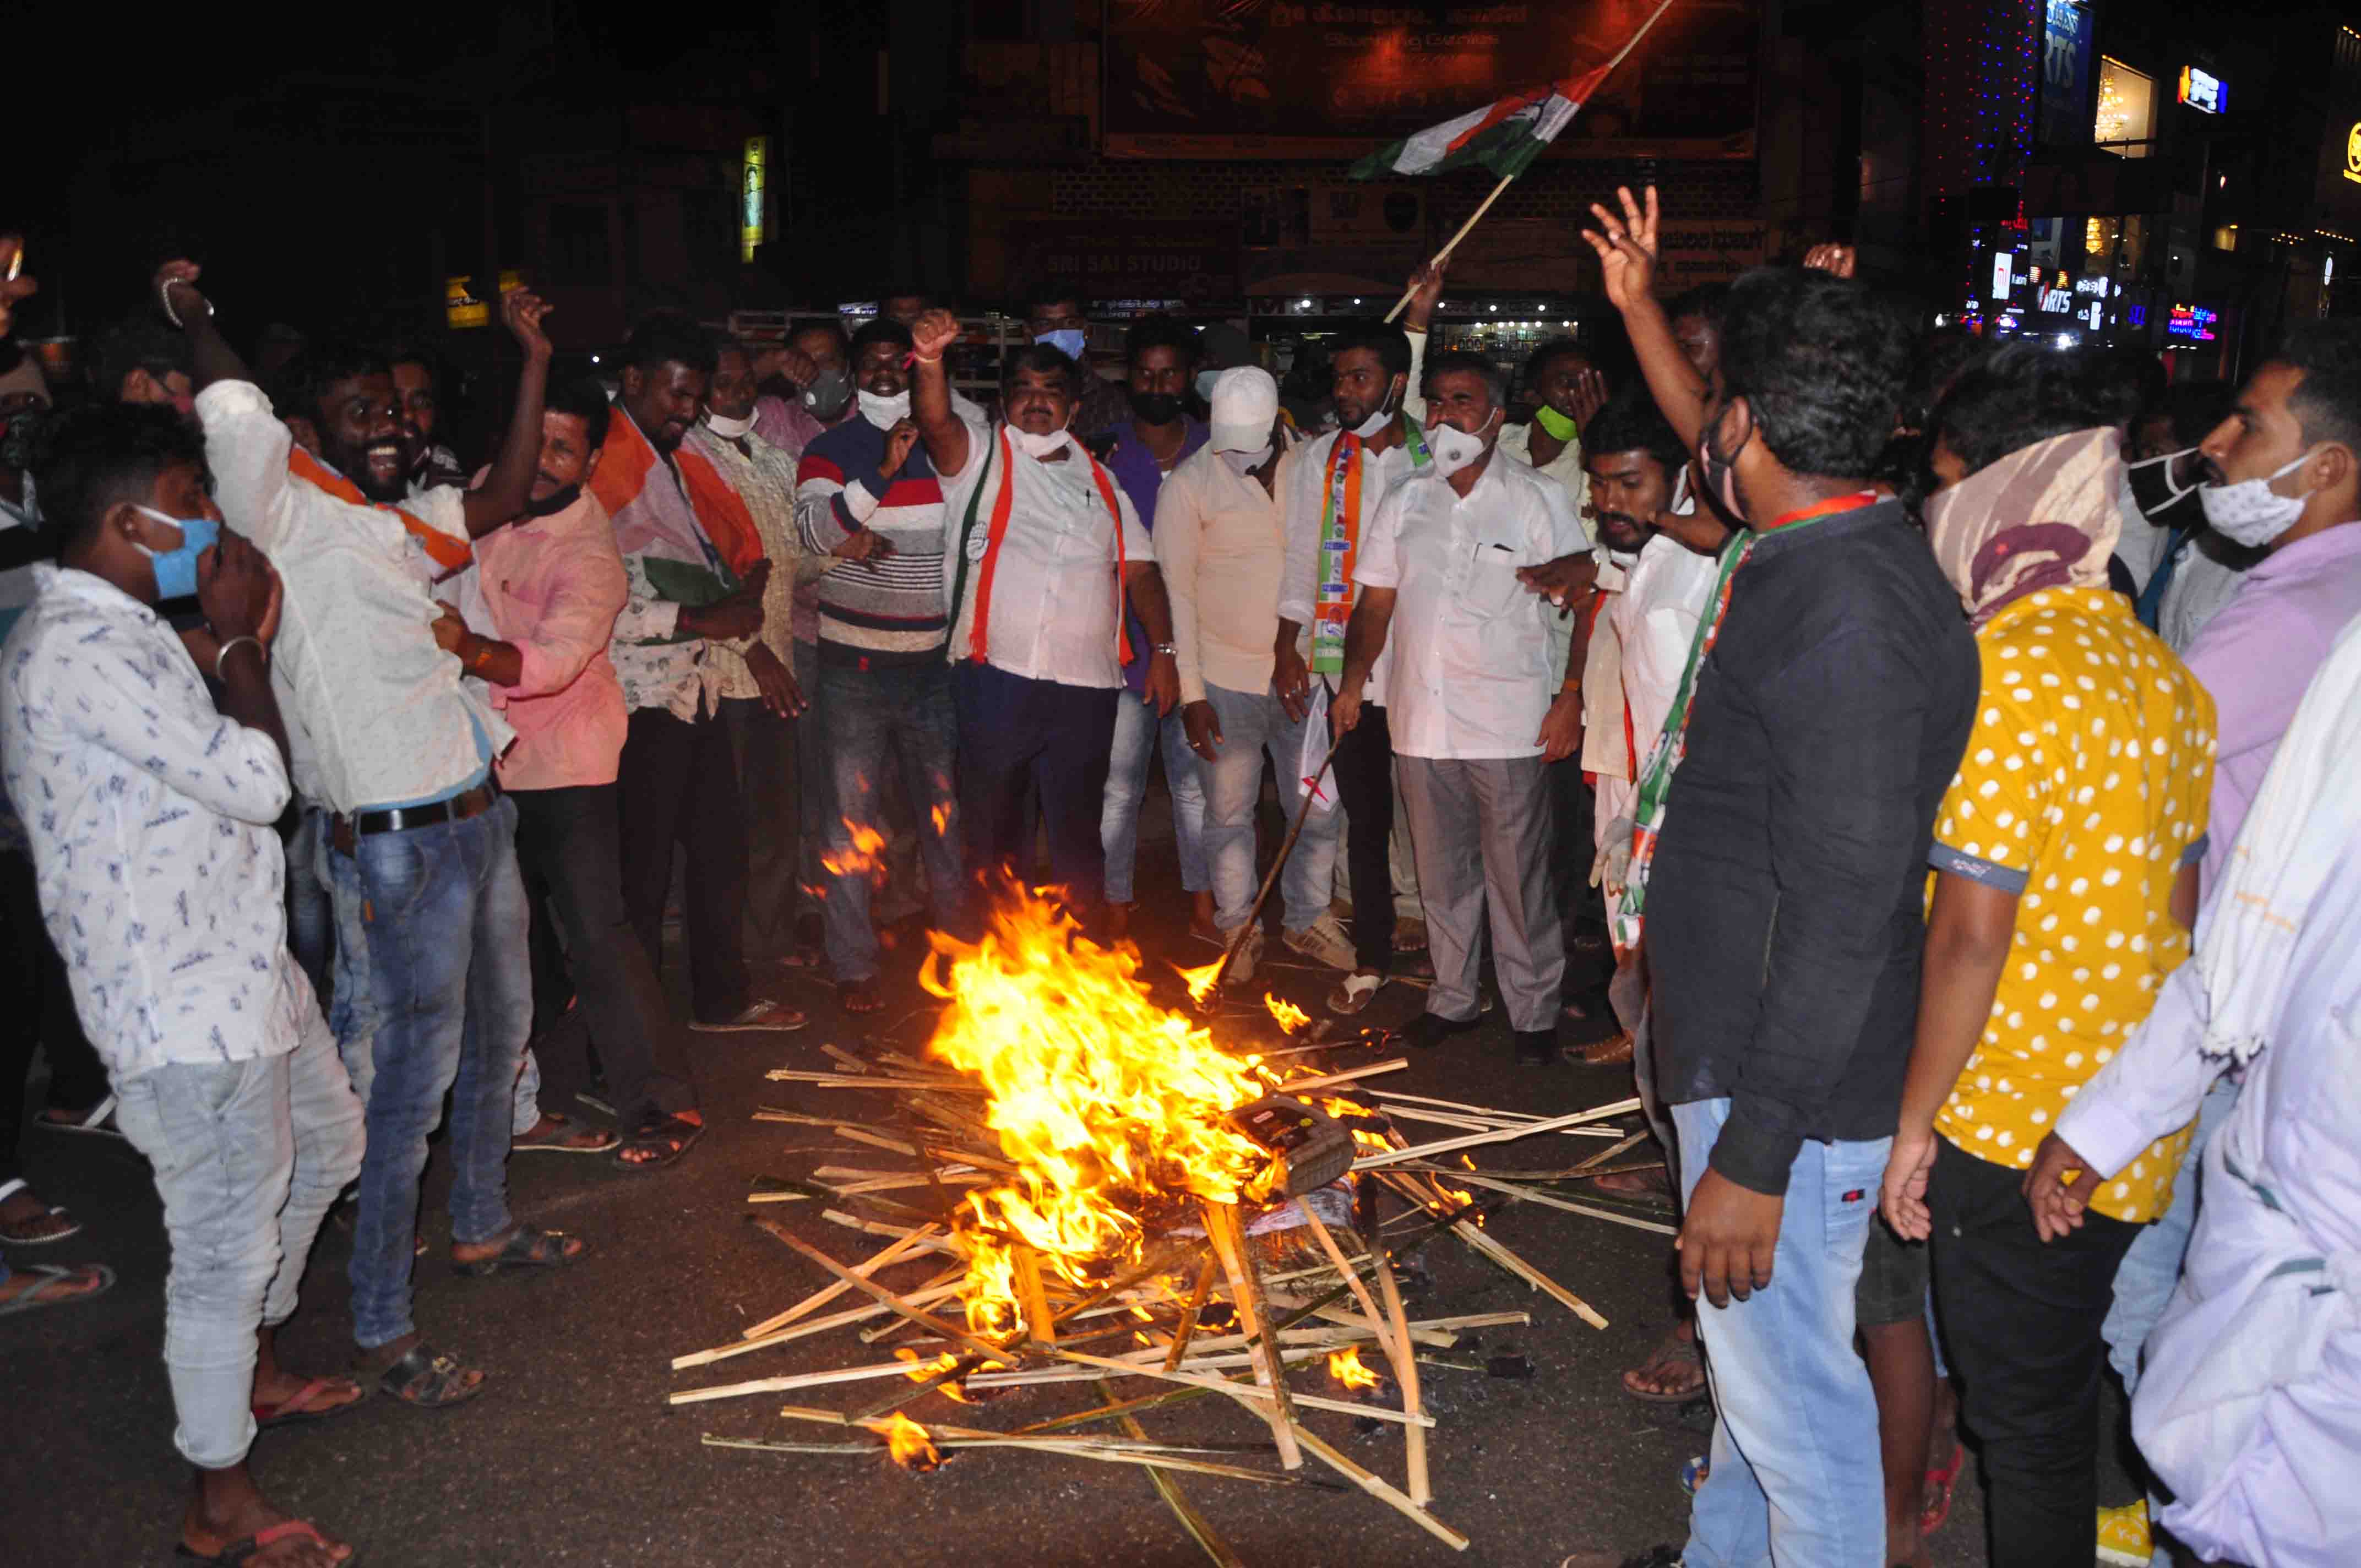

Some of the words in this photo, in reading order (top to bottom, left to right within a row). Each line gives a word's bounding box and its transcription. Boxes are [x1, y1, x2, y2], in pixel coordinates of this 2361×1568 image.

[1048, 255, 1080, 273] SRI
[1087, 255, 1119, 273] SAI
[1127, 255, 1201, 273] STUDIO
